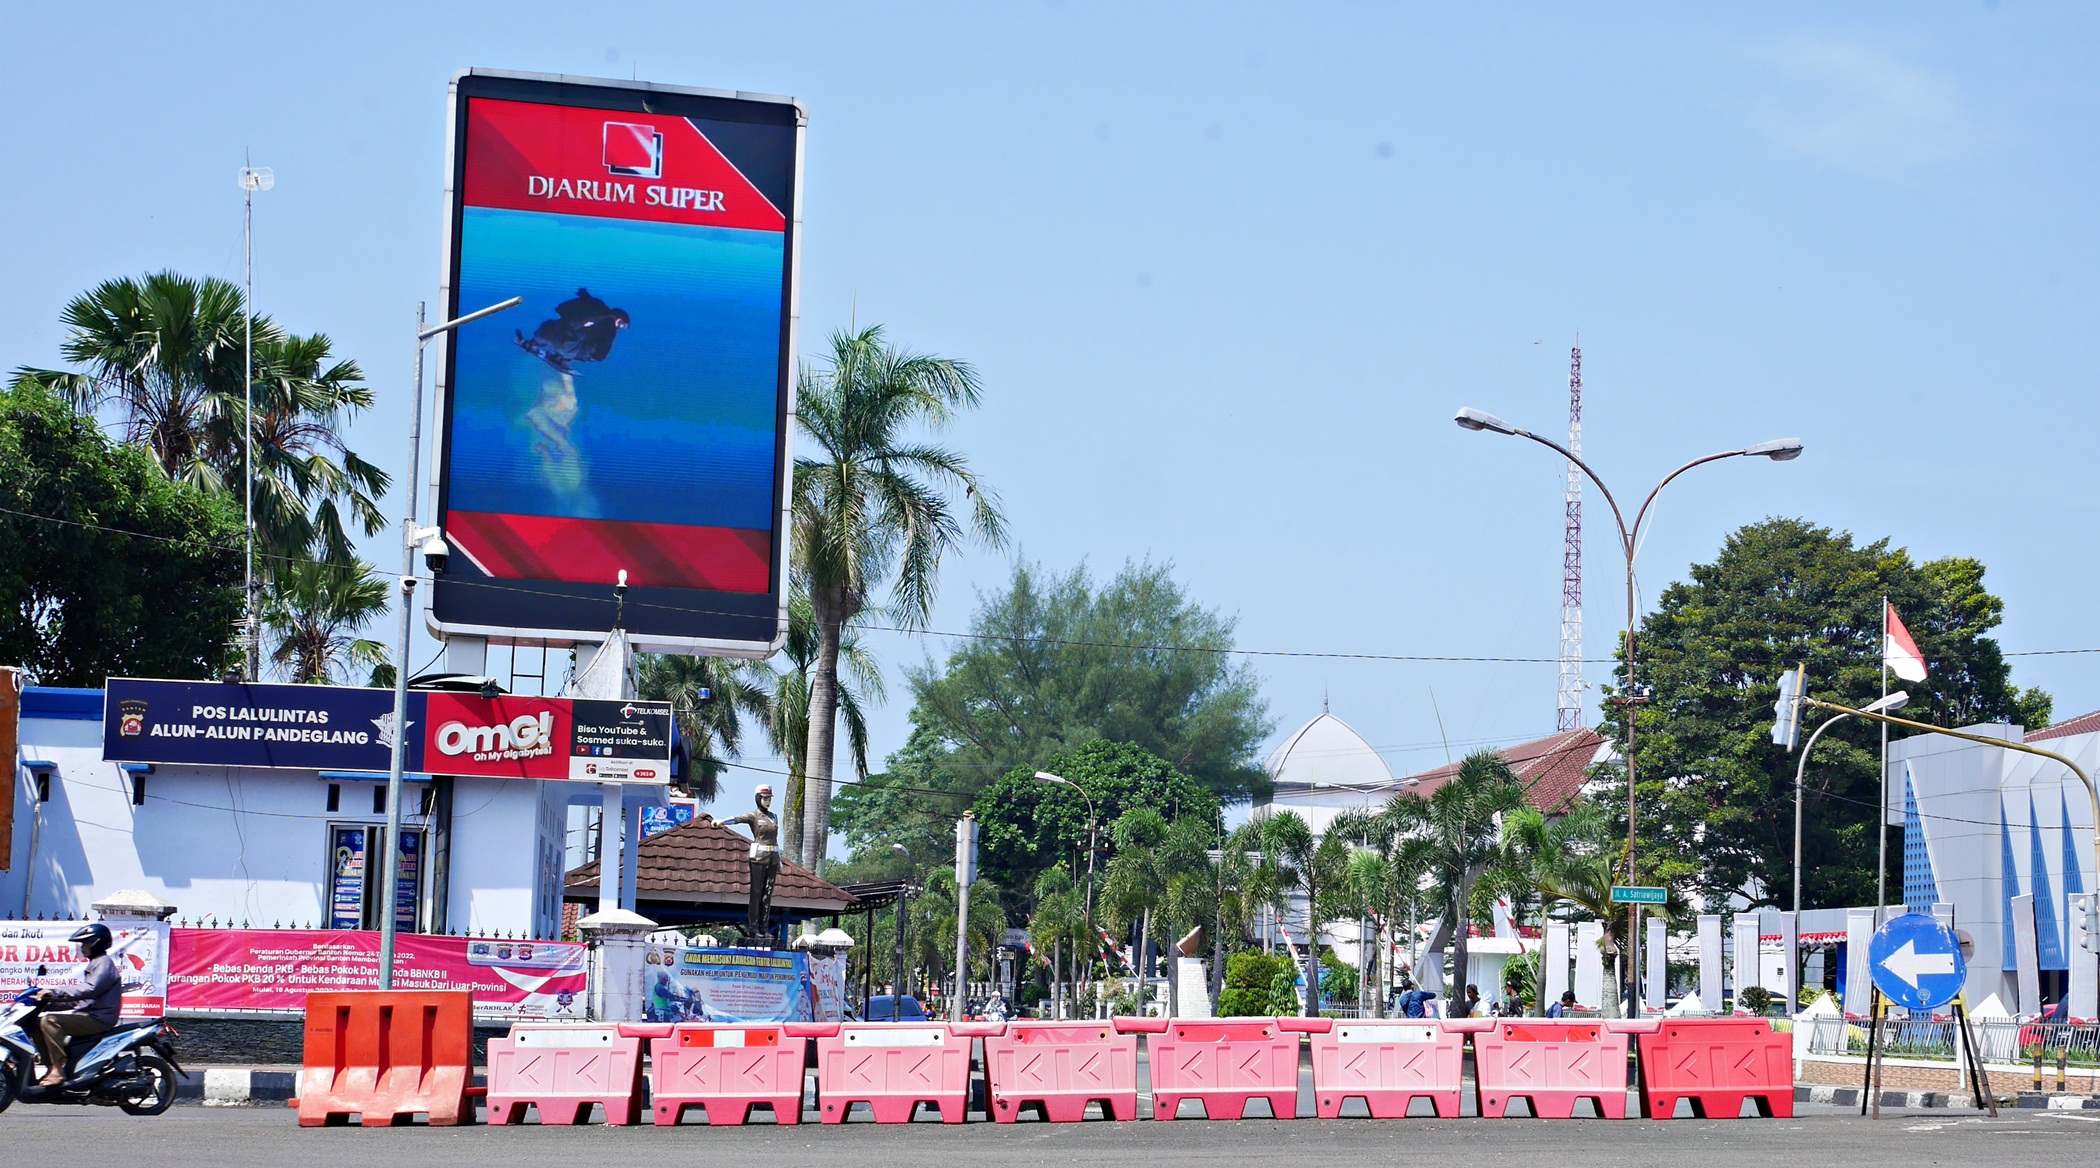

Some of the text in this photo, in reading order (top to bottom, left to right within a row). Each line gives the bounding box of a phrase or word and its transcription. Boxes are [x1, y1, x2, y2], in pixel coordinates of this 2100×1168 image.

[528, 175, 726, 212] DJARUM SUPER
[192, 705, 329, 724] POS LALULINTAS
[636, 707, 670, 716] TELKOMSEL
[150, 723, 369, 745] ALUN-ALUN PANDEGLANG
[577, 724, 647, 735] Bisa YouTube &
[577, 735, 667, 747] Sosmed suka-suka.
[473, 746, 553, 762] Oh My Gigabytes!
[1630, 890, 1664, 901] Satriawijaya
[2, 928, 44, 939] dan Ikuti
[213, 963, 242, 973] Bebas
[243, 964, 274, 974] Denda
[275, 964, 295, 974] PKB
[300, 965, 330, 974] Bebas
[331, 965, 359, 975] Pokok
[360, 966, 379, 976] Dan
[392, 968, 409, 978] nda
[410, 968, 440, 979] BBNKB
[680, 968, 705, 976] GUNAKAN
[1, 977, 26, 985] MERAH
[28, 977, 66, 986] NDONESIA
[68, 978, 78, 986] KE
[211, 973, 241, 983] Pokok
[241, 974, 261, 984] PKB
[262, 974, 274, 984] 20
[276, 975, 285, 984] %
[288, 975, 317, 984] Untuk
[318, 975, 367, 986] Kendaraan
[368, 976, 400, 988] Musi
[401, 978, 431, 989] Masuk
[431, 980, 450, 990] Dari
[450, 981, 470, 991] Luar
[471, 981, 507, 992] Provinsi
